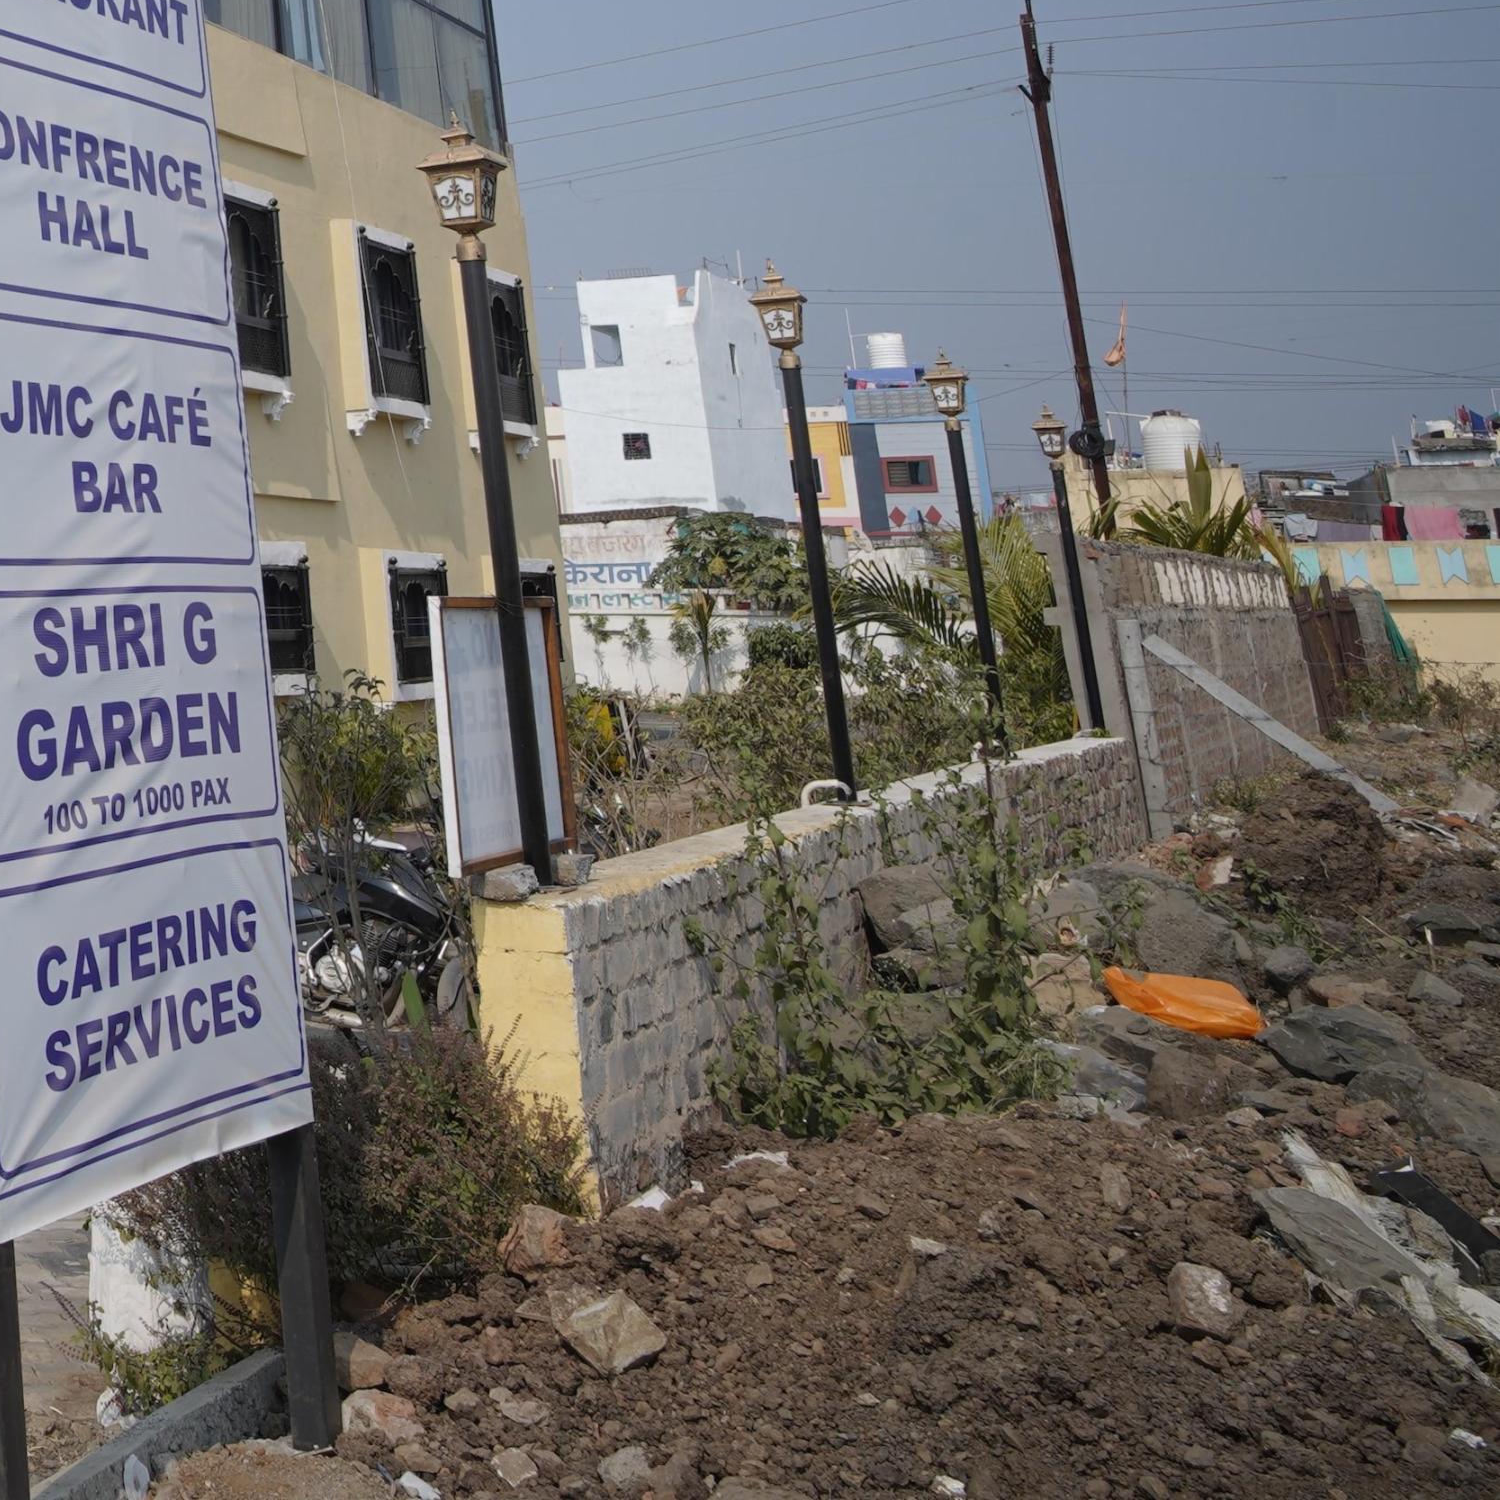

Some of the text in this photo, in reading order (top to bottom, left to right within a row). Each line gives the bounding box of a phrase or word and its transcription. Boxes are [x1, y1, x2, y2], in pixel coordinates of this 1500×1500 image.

[37, 190, 149, 261] HALL
[0, 379, 212, 448] JMC CAFÉ
[71, 460, 162, 514] BAR
[32, 601, 217, 679] SHRI G
[16, 690, 241, 782] GARDEN
[43, 776, 232, 836] 100 TO 1000 PAX
[36, 899, 257, 1007] CATERING
[45, 974, 261, 1092] SERVICES
